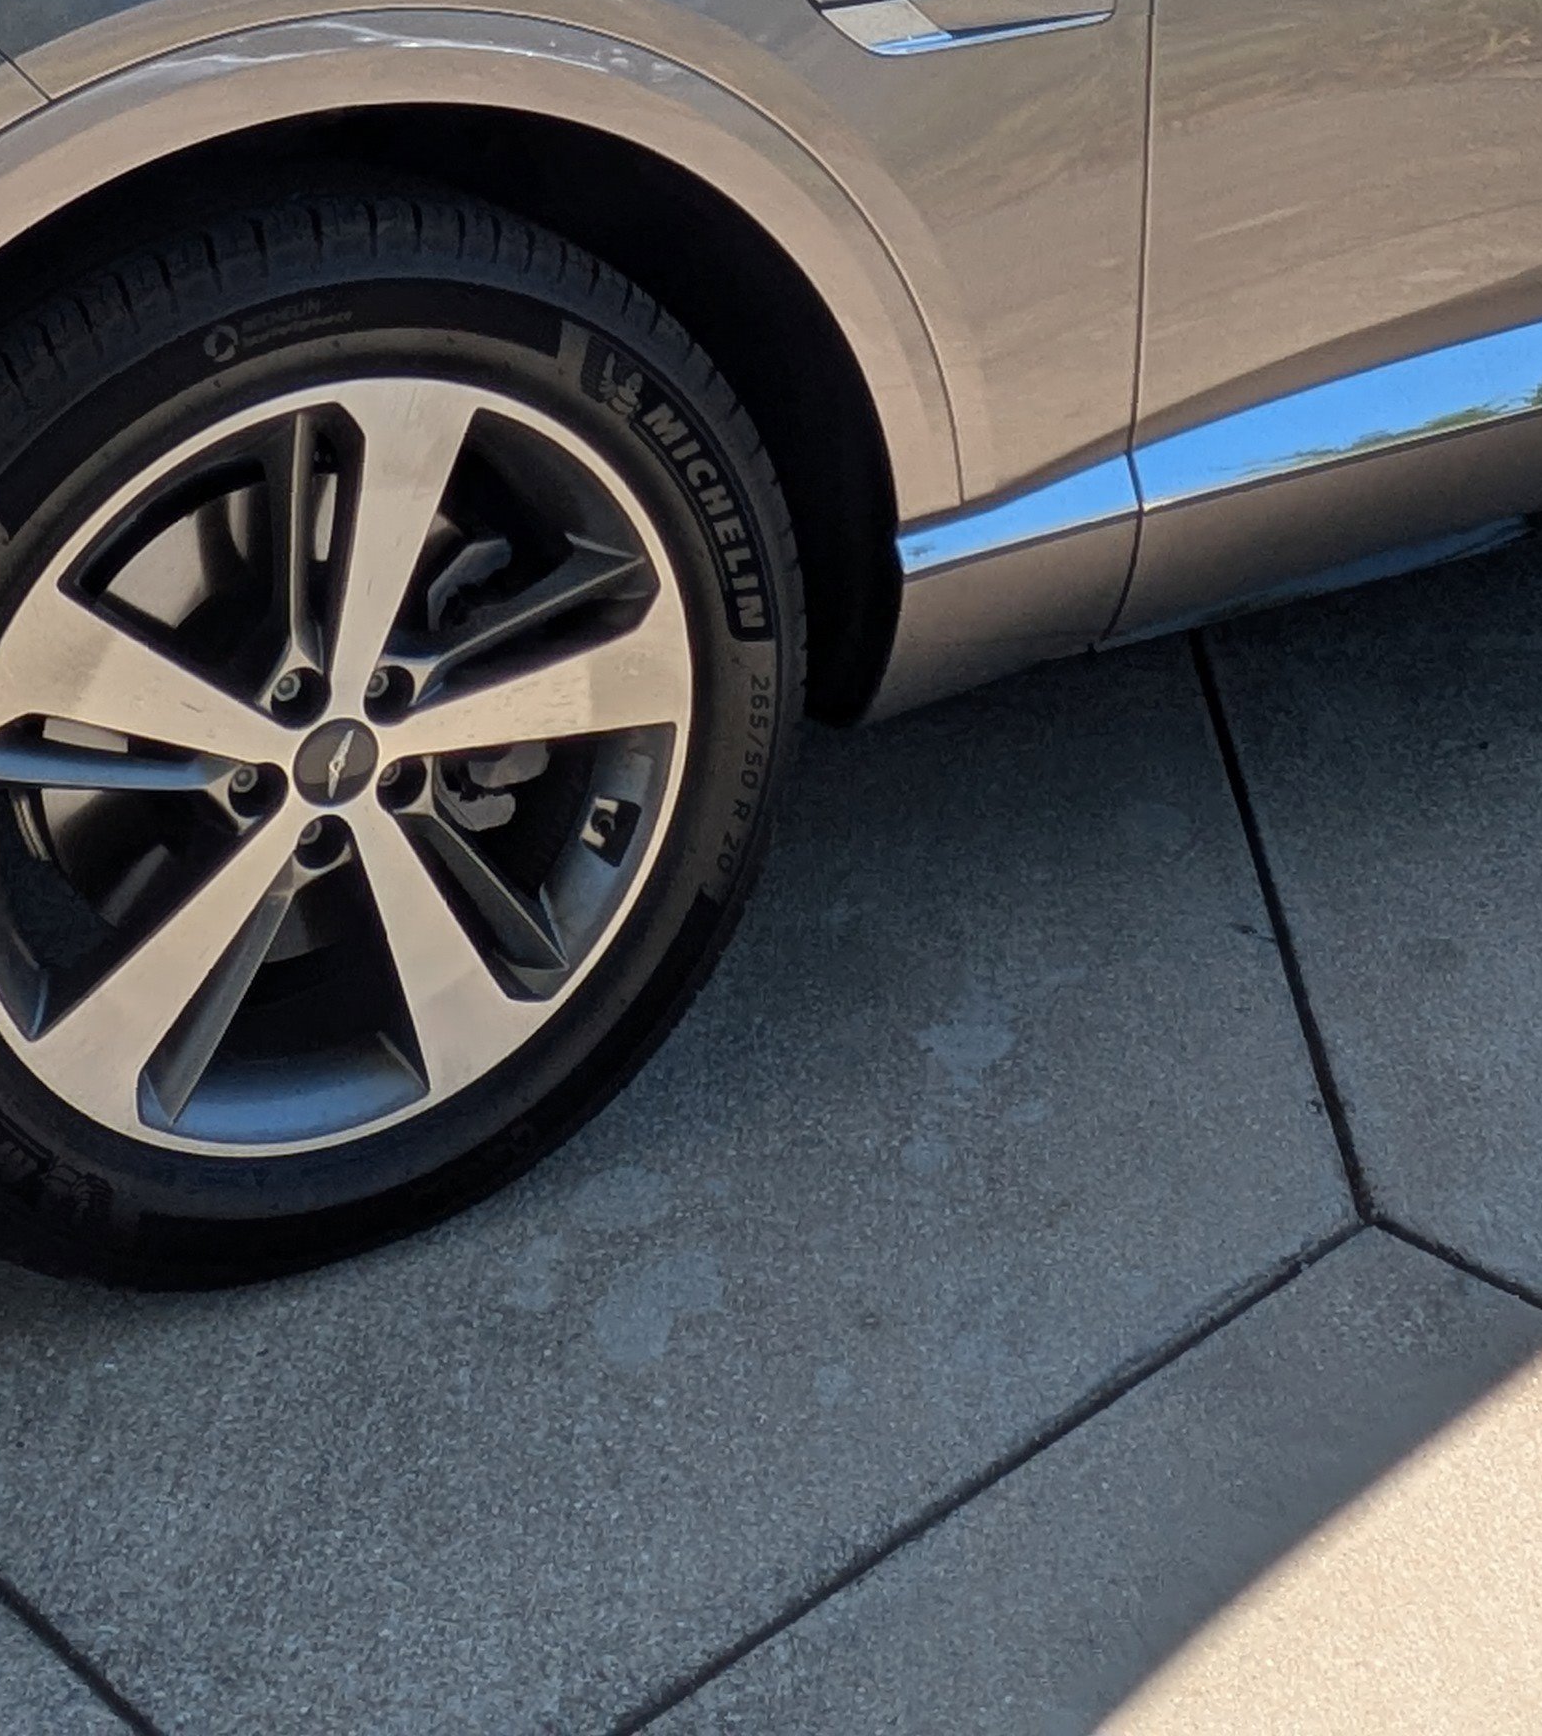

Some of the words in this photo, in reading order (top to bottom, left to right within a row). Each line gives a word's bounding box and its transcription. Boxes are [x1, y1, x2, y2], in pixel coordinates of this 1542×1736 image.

[641, 402, 767, 629] MICHELIN
[739, 672, 771, 791] 265/50
[732, 798, 752, 822] R
[716, 830, 741, 874] 20
